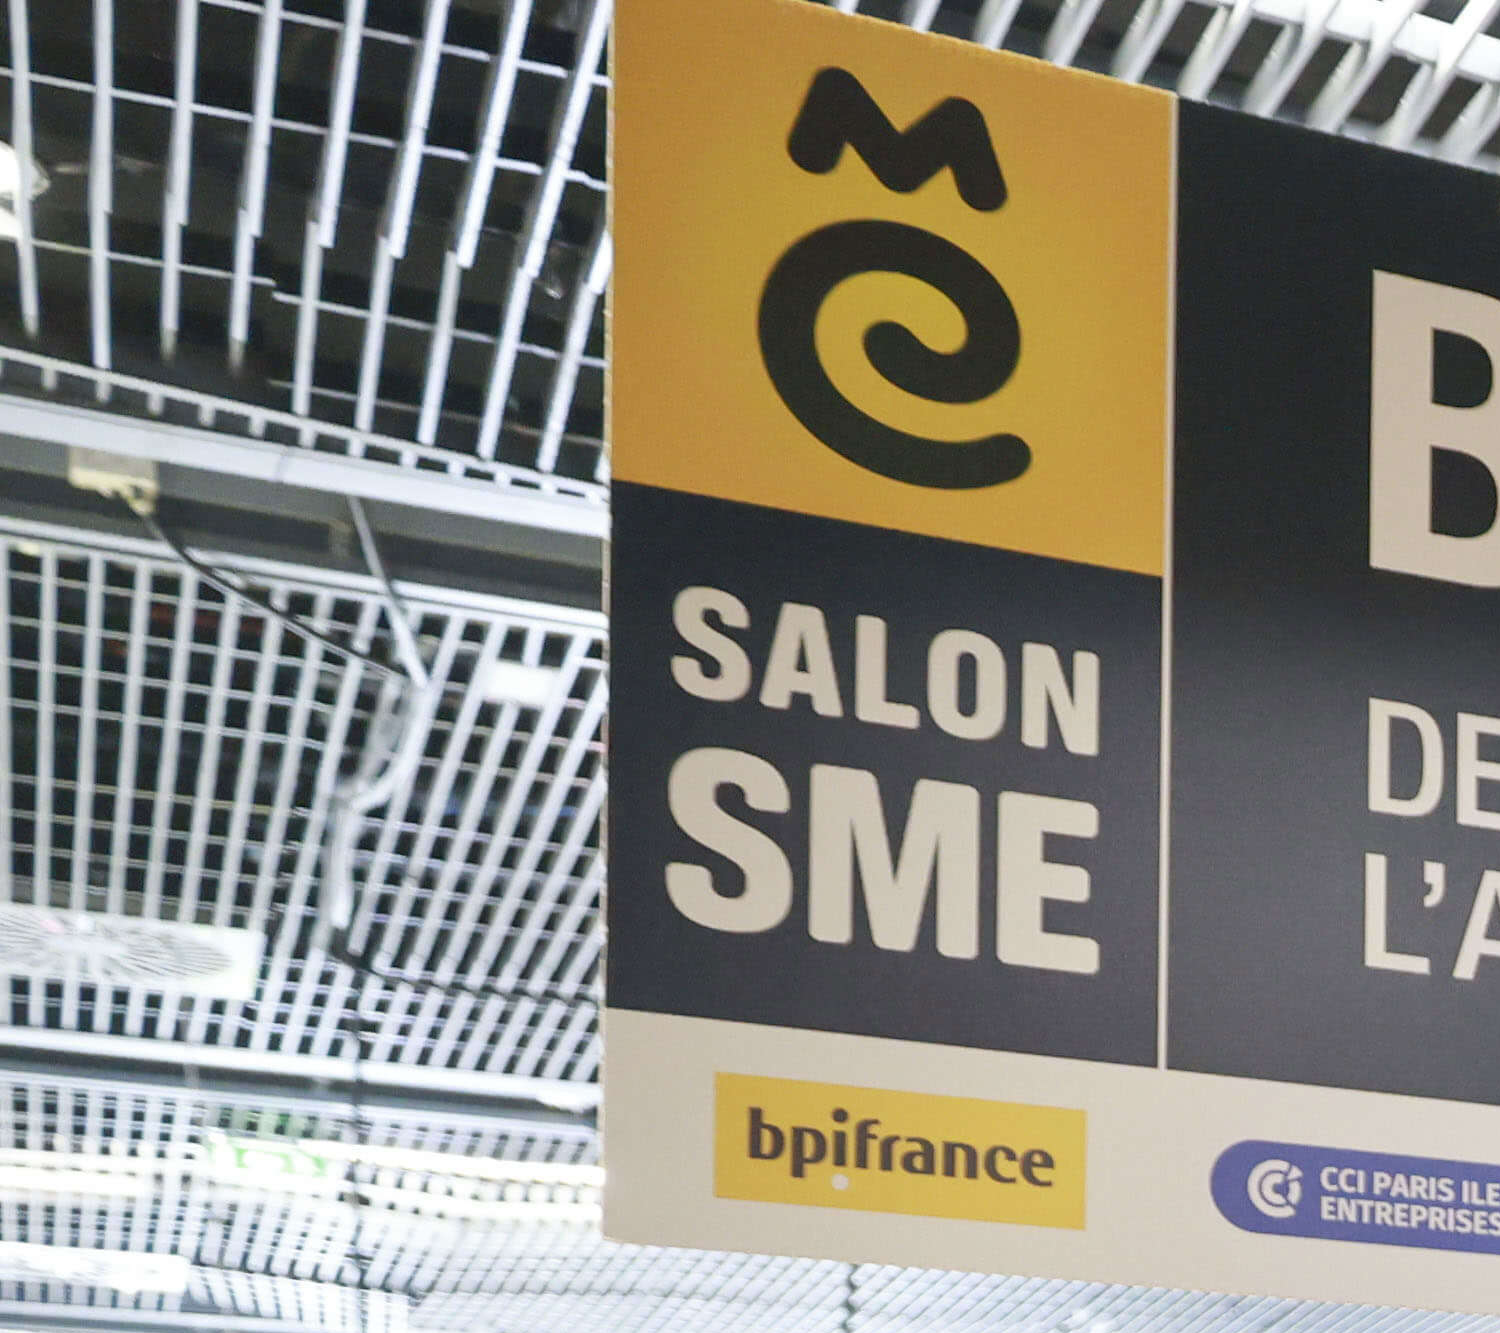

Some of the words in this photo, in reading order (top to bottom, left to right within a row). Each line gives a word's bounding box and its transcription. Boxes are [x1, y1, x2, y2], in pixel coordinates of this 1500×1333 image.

[673, 588, 1098, 755] SALON
[667, 748, 1099, 974] SME
[748, 1106, 1055, 1187] bpifrance
[1320, 1166, 1365, 1194] CCI
[1374, 1170, 1453, 1203] PARIS
